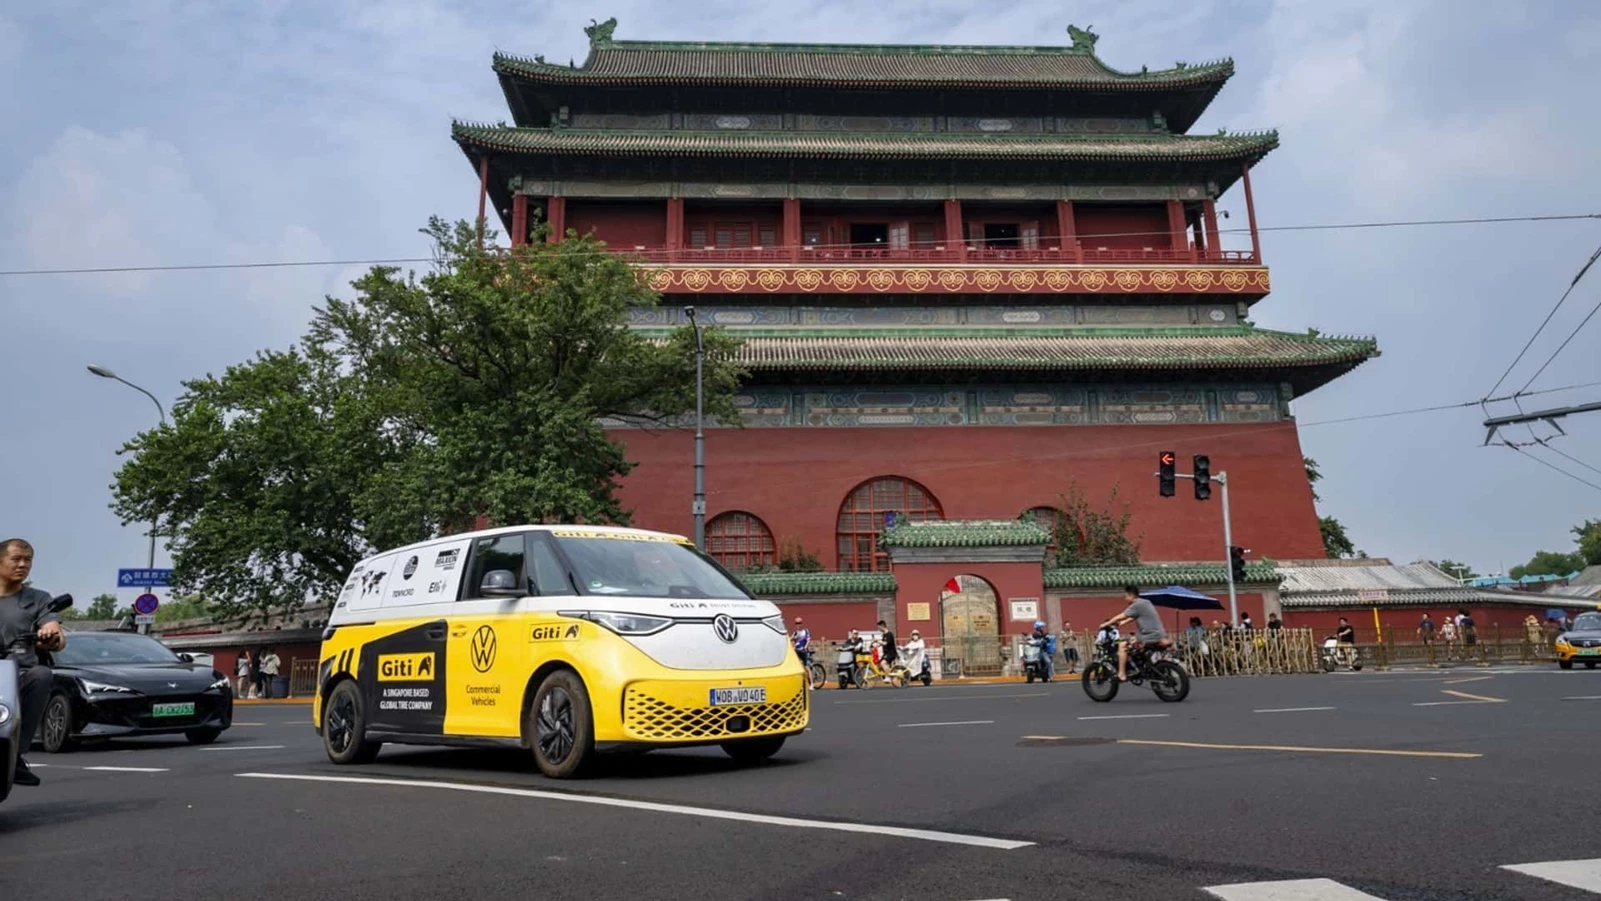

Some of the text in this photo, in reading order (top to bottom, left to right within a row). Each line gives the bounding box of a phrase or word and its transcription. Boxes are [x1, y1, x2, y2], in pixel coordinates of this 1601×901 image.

[532, 627, 561, 640] Giti
[382, 658, 412, 677] Giti
[387, 688, 413, 697] SINGAPORE
[413, 688, 430, 697] BASED
[466, 684, 501, 694] Commercial
[380, 700, 399, 710] GLOBAL
[408, 700, 433, 710] COMPANY
[471, 696, 496, 706] Vehicles
